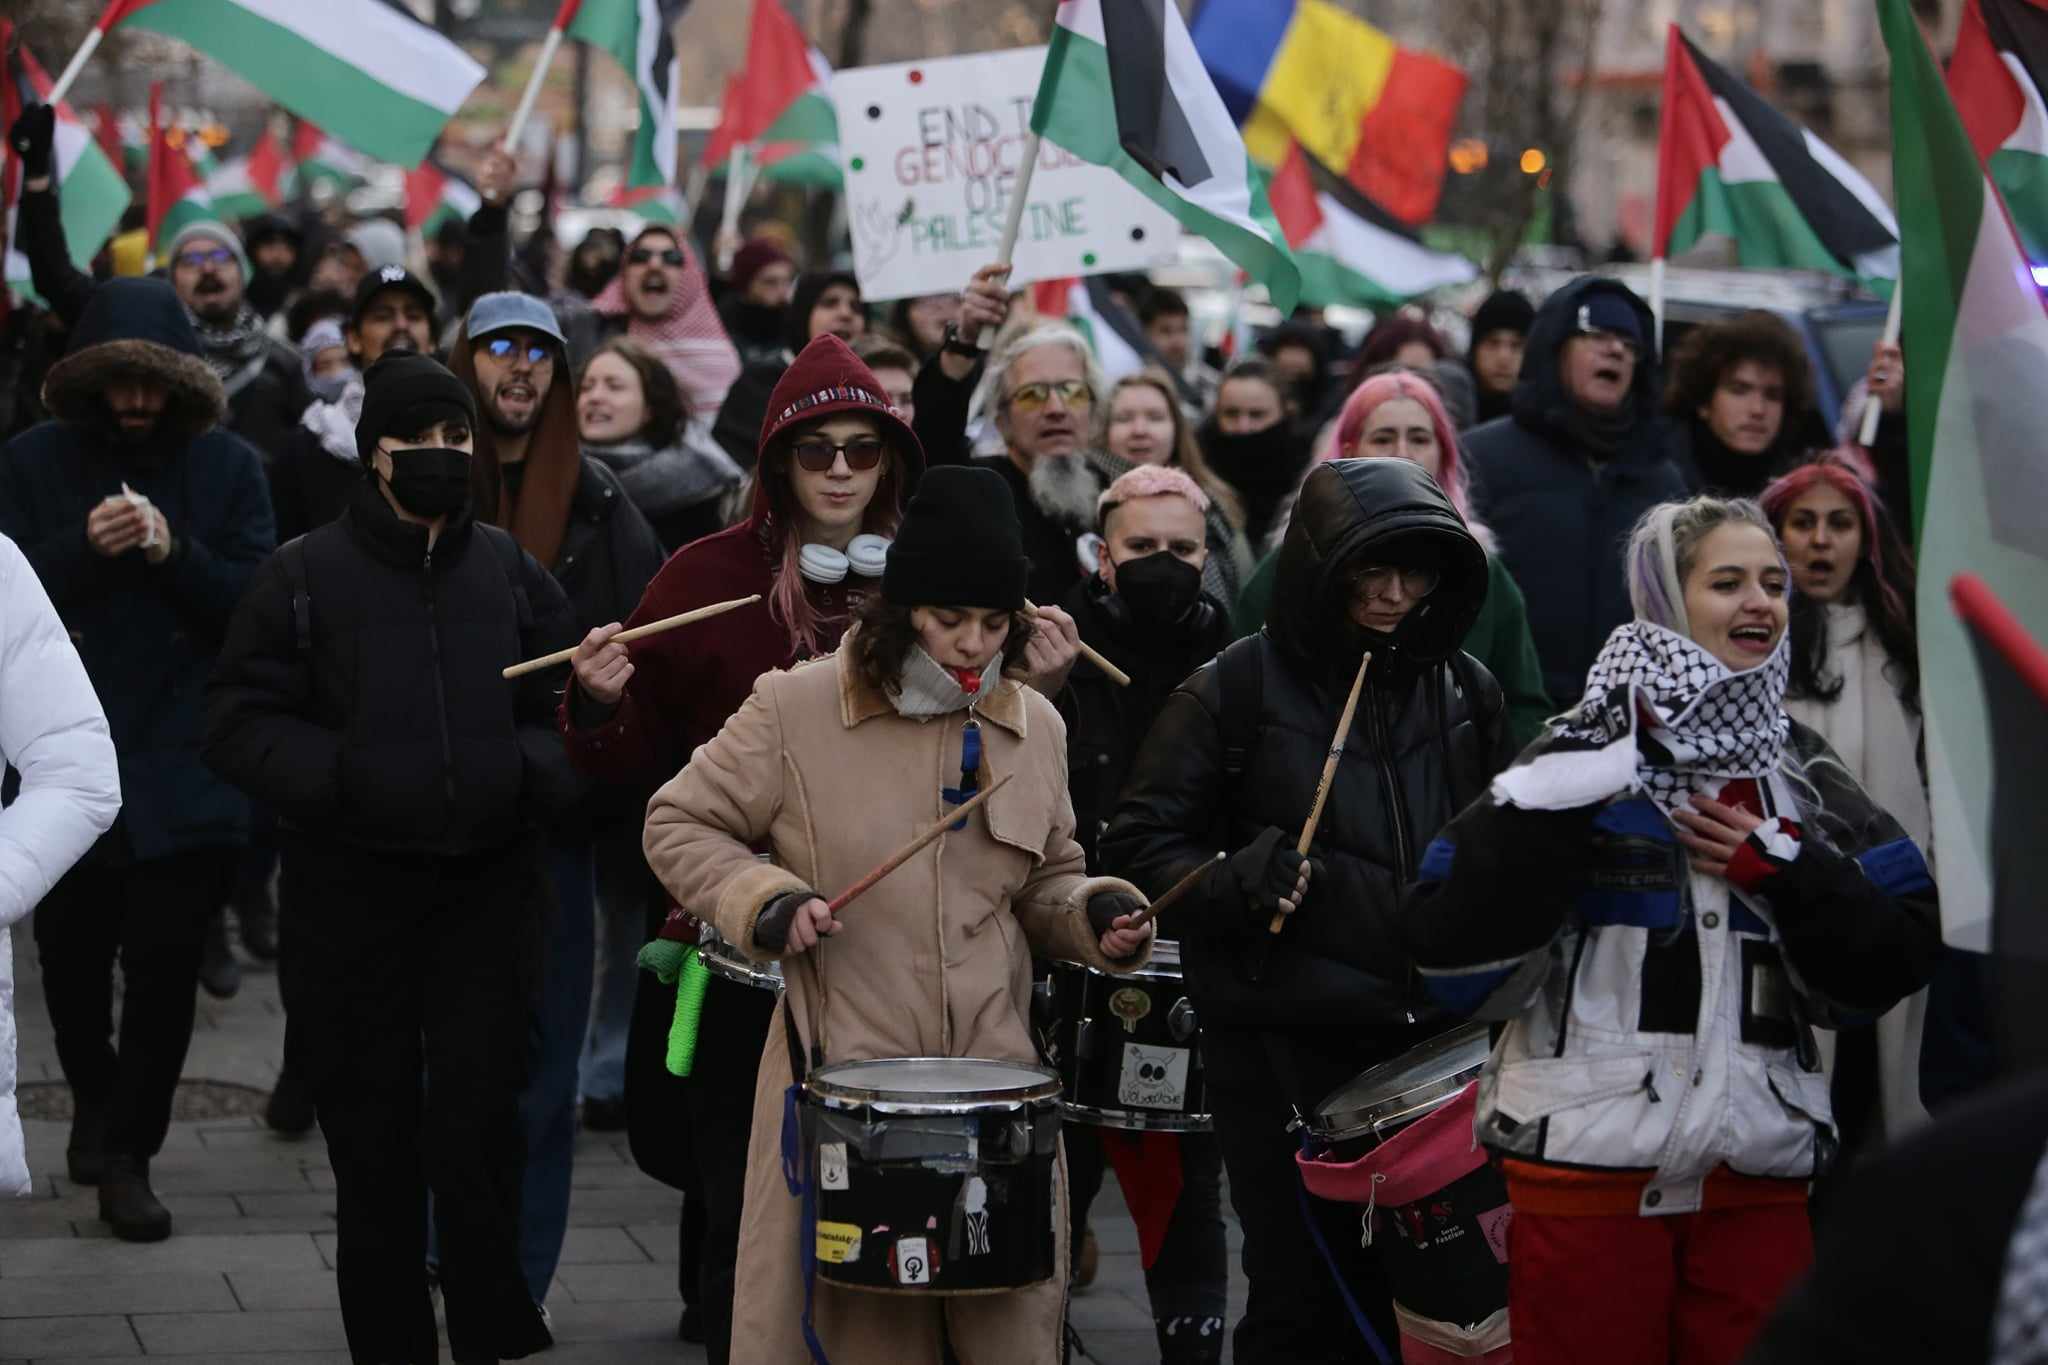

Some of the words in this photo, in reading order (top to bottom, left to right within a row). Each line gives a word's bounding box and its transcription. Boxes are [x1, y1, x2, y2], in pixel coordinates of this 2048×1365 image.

[918, 104, 1000, 148] END
[895, 133, 1088, 187] GENOCD
[964, 170, 1016, 216] OF
[911, 197, 1089, 256] PALESINE
